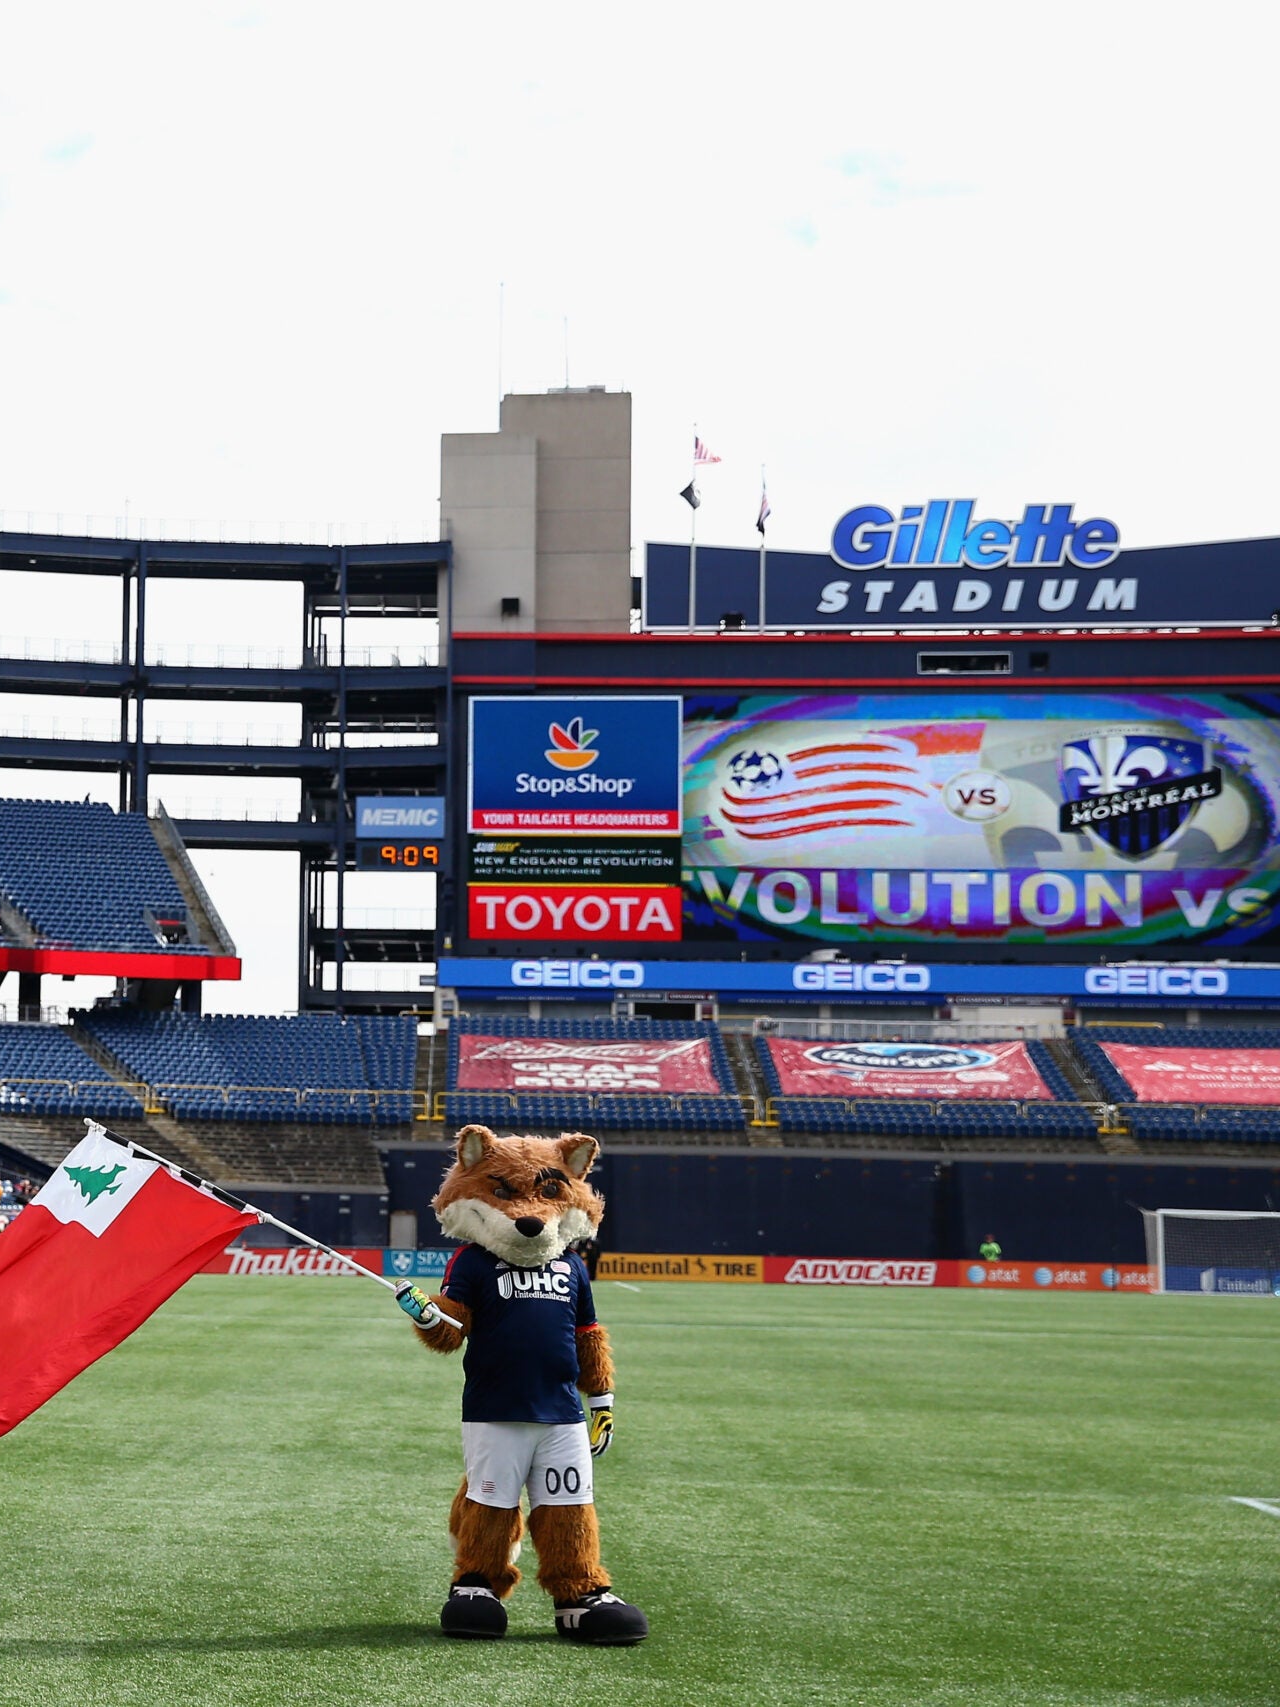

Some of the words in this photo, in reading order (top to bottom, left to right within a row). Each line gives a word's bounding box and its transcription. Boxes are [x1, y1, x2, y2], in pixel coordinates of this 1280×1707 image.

[830, 499, 1120, 570] Gillette
[817, 578, 1138, 613] STADIUM
[515, 773, 634, 797] Stop&Shop
[361, 808, 439, 827] MEMIC
[483, 813, 514, 825] YOUR
[517, 813, 572, 826] TAILGATE
[574, 814, 669, 826] HEADQUARTERS
[381, 845, 439, 867] 9:09
[474, 856, 506, 865] NEW
[509, 856, 578, 866] ENGLAND
[583, 856, 674, 866] REVOLUTION
[681, 870, 1143, 929] VOLUTION
[476, 895, 674, 932] TOYOTA
[511, 960, 645, 987] GEICO
[792, 964, 931, 992] GEICO
[1084, 967, 1229, 996] GEICO
[512, 1271, 570, 1294] UHC
[713, 1262, 757, 1277] TIRE
[785, 1259, 936, 1285] ADVOCARE
[514, 1291, 572, 1303] UnitedHealthcare
[545, 1466, 580, 1495] 00
